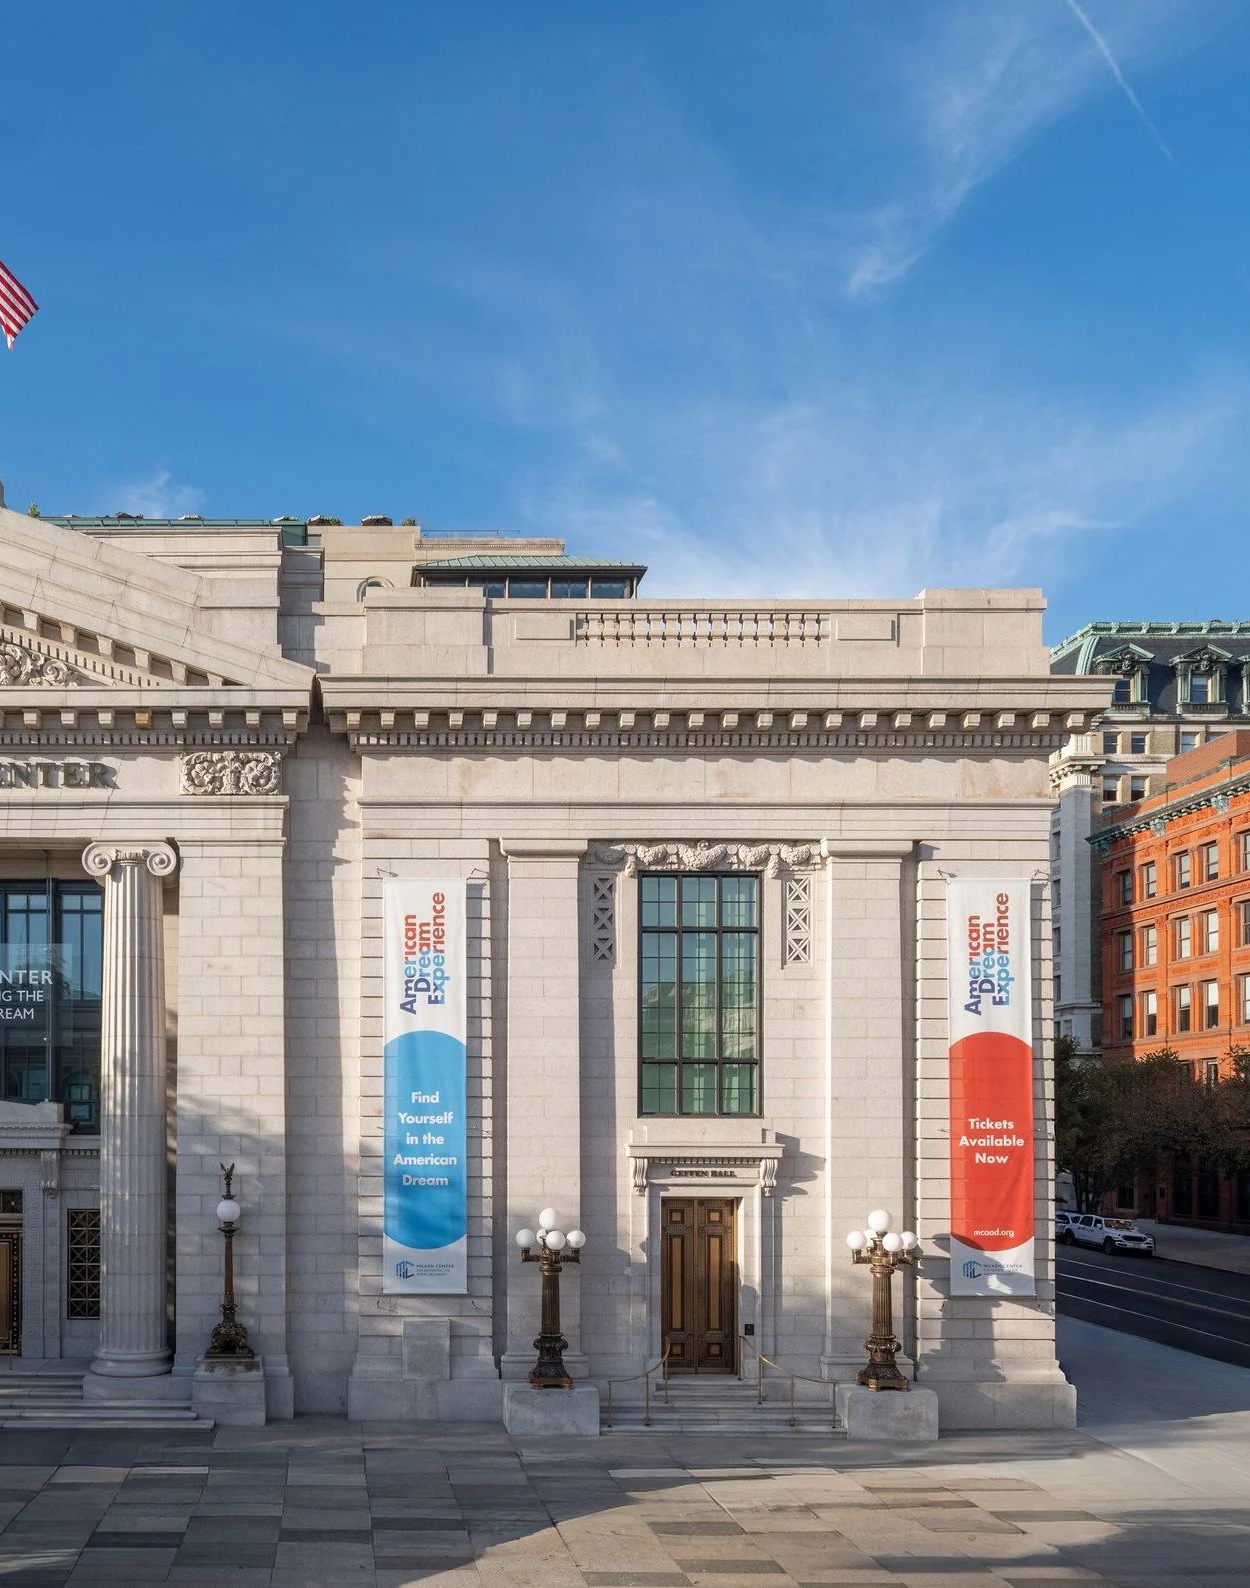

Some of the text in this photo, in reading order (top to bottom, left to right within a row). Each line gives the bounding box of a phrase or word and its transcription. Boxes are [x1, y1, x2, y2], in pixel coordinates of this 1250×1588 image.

[428, 892, 450, 1004] Experience
[992, 892, 1015, 1005] Experience
[414, 922, 431, 992] Dream
[978, 922, 995, 993] Dream
[399, 914, 417, 1015] American
[964, 915, 982, 1016] American
[16, 990, 44, 1002] THE
[411, 1090, 440, 1104] Find
[397, 1111, 454, 1124] Yourself
[968, 1117, 1015, 1130] Tickets
[406, 1131, 445, 1145] in the
[959, 1134, 1025, 1147] Available
[393, 1153, 457, 1166] American
[975, 1152, 1010, 1164] Now
[402, 1174, 449, 1186] Dream
[710, 1170, 737, 1178] HALL
[973, 1227, 1015, 1238] mcaad.org
